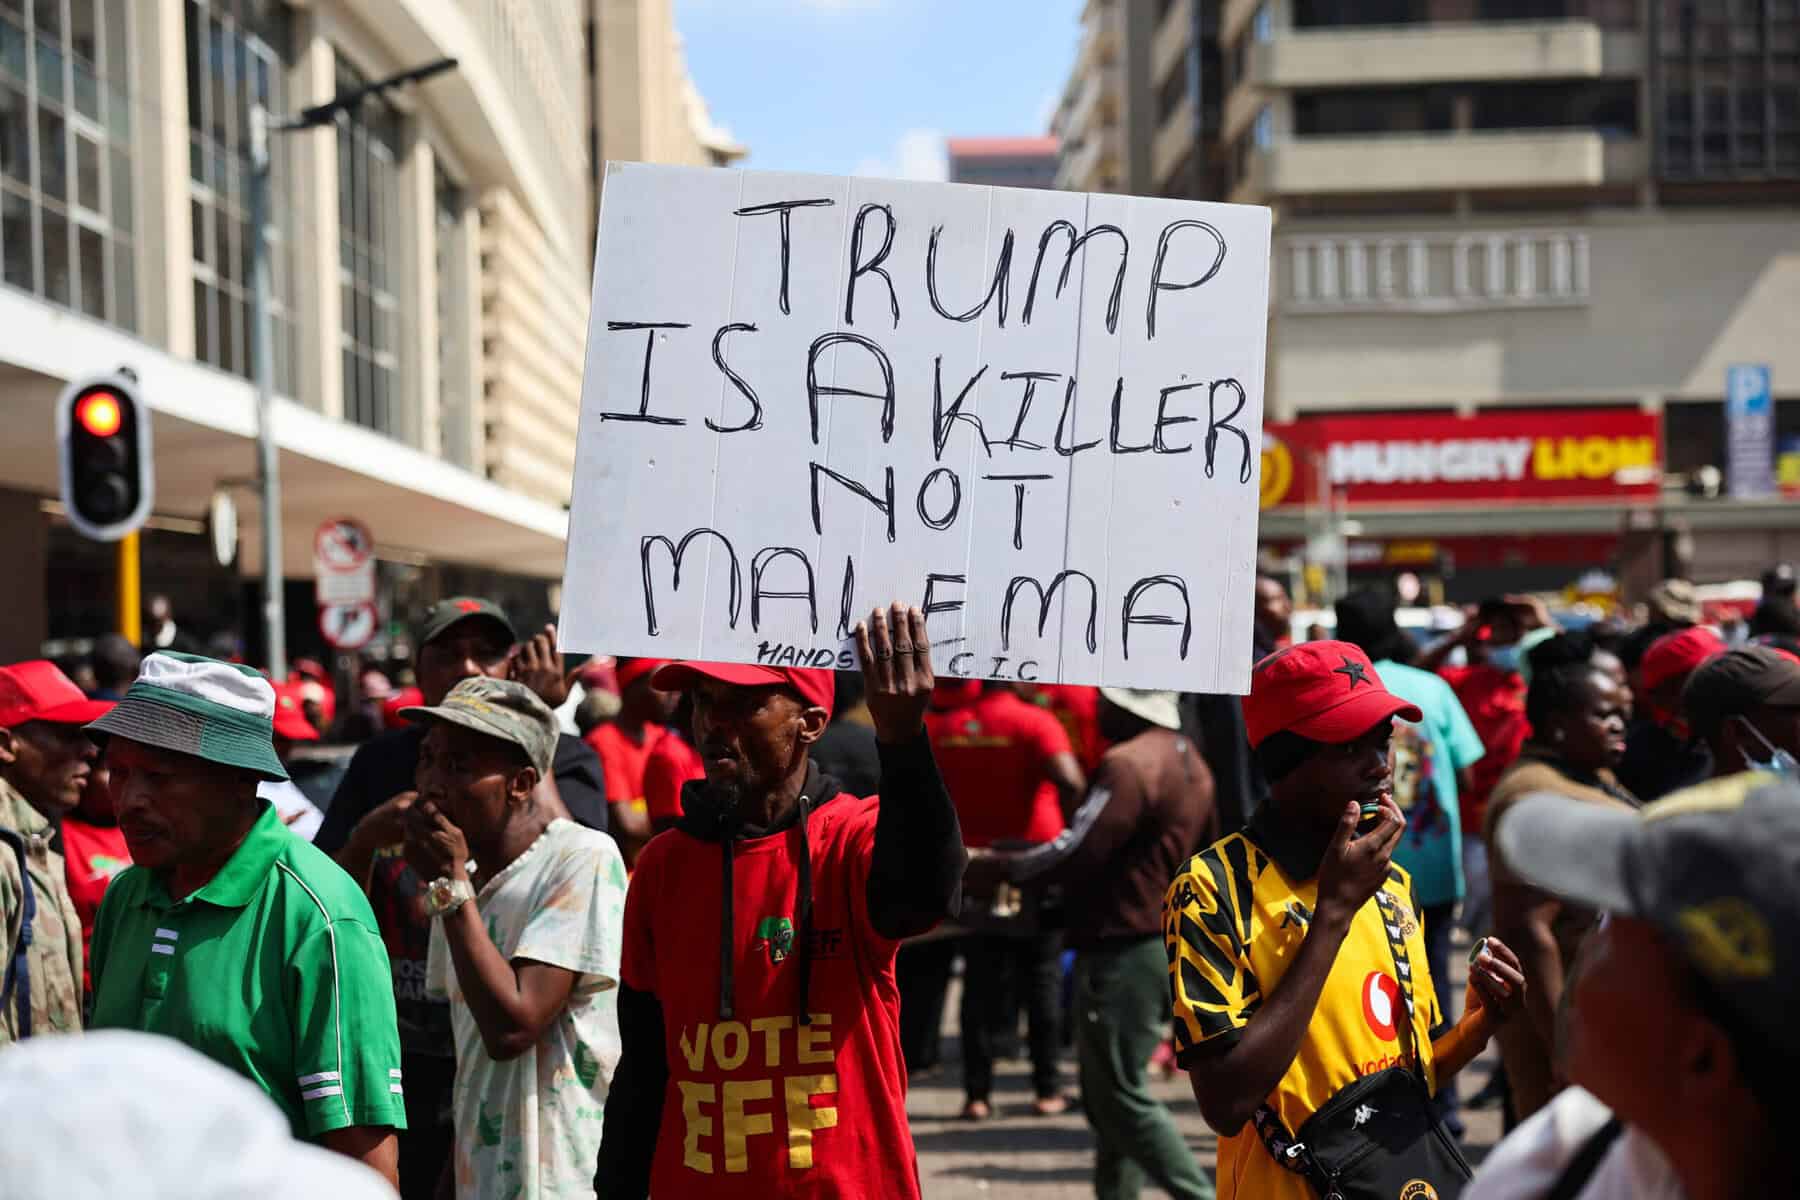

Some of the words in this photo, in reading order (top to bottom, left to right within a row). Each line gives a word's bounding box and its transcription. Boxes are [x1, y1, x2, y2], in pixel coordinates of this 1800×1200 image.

[733, 199, 1226, 340] TRUMP
[600, 322, 763, 433] IS
[807, 332, 895, 444] A
[933, 357, 1251, 483] KILLER
[809, 461, 1053, 550] NOT
[1329, 438, 1531, 484] HUNGRY
[1533, 435, 1655, 480] LION
[641, 527, 1191, 660] MALEMA
[756, 640, 854, 668] HANDS
[680, 1013, 835, 1072] VOTE
[677, 1073, 838, 1174] EFF
